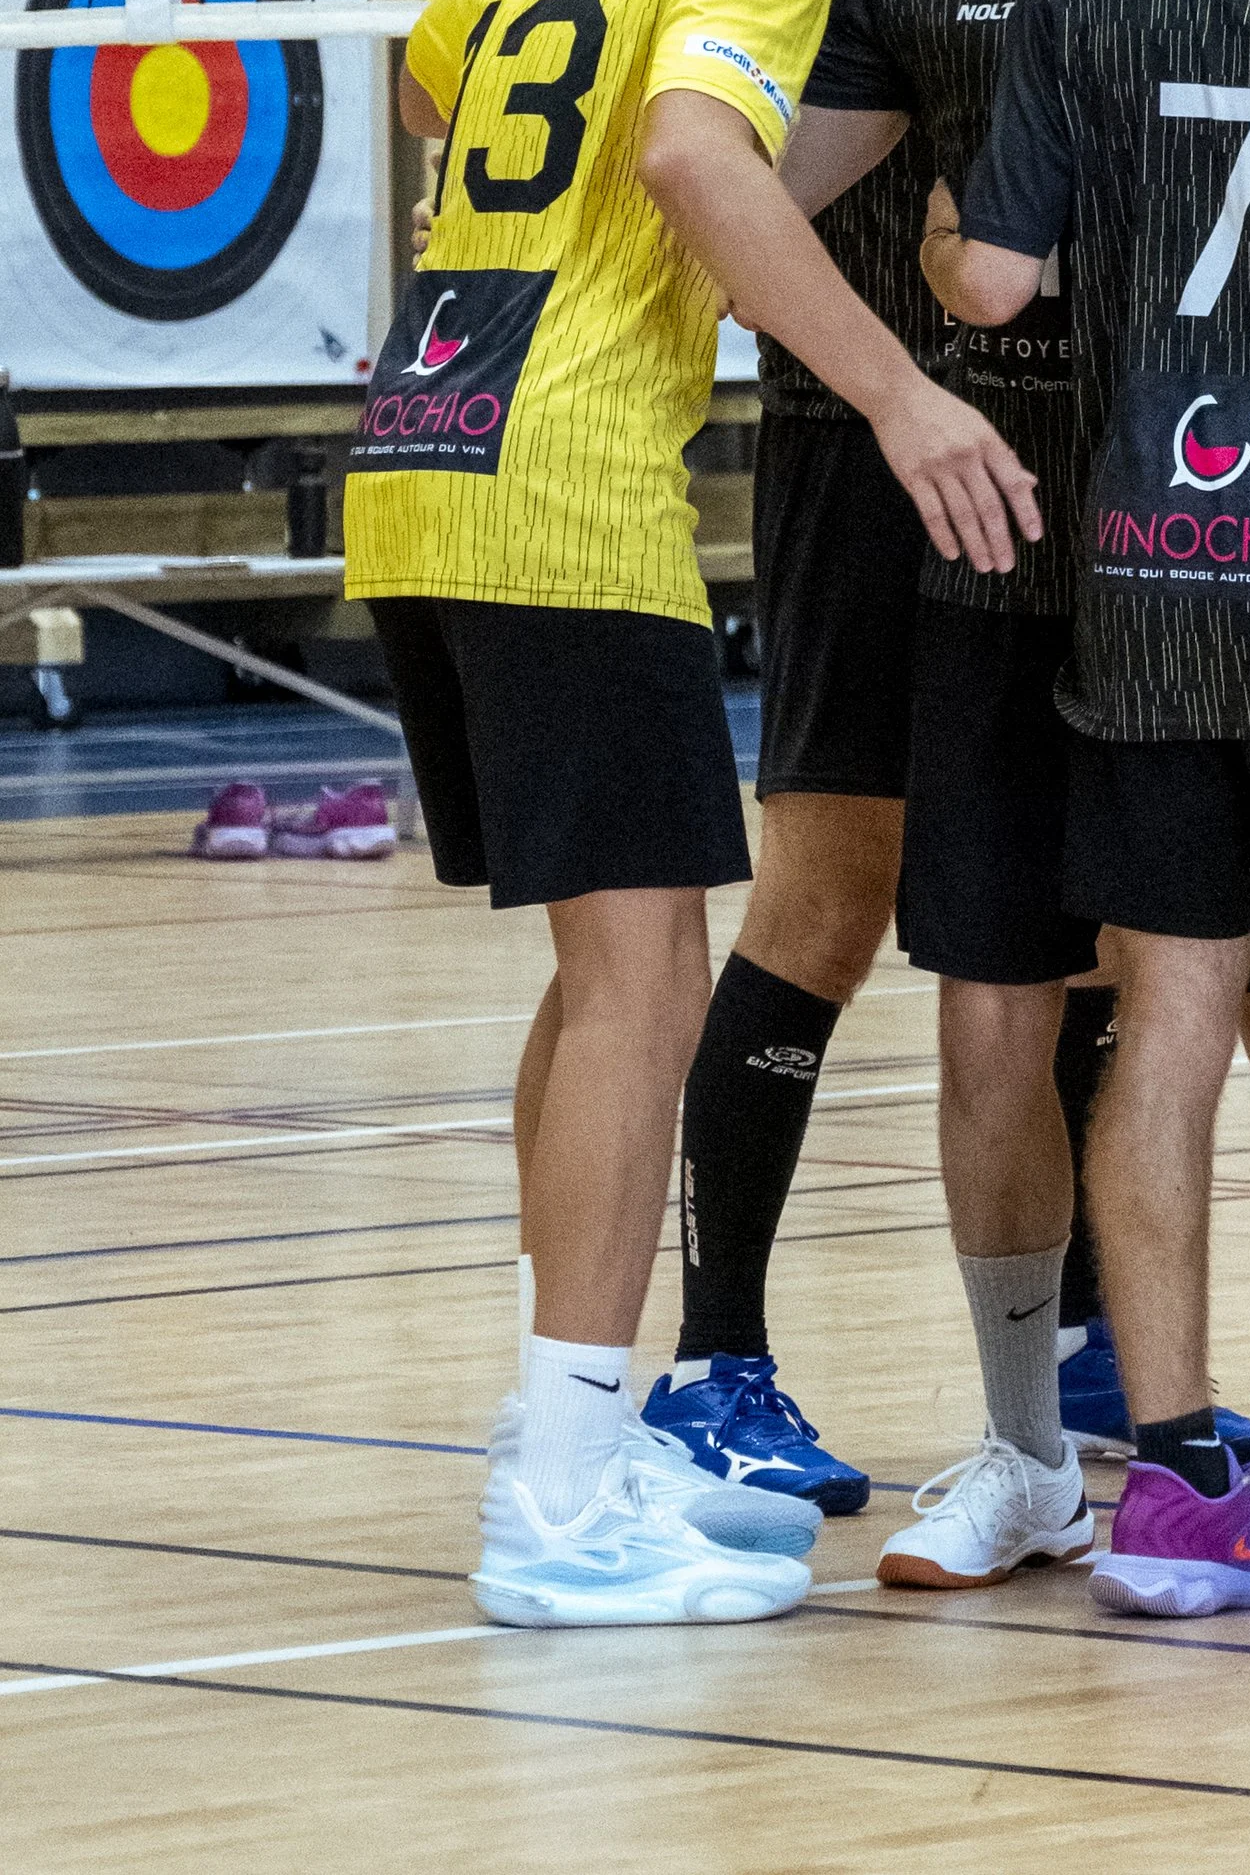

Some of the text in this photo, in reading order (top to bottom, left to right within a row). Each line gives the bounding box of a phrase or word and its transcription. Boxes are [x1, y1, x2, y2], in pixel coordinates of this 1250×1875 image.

[956, 2, 1015, 21] NOLT
[702, 40, 752, 72] Crédit
[969, 330, 1070, 359] LE FOYE
[367, 445, 395, 455] BOUGE
[397, 444, 434, 453] AUTOUR
[439, 444, 455, 453] DU
[463, 445, 485, 455] VIN
[1094, 562, 1103, 574] LA
[1106, 566, 1134, 578] CAVE
[1139, 569, 1163, 579] QUI
[1170, 569, 1214, 581] BOUGE
